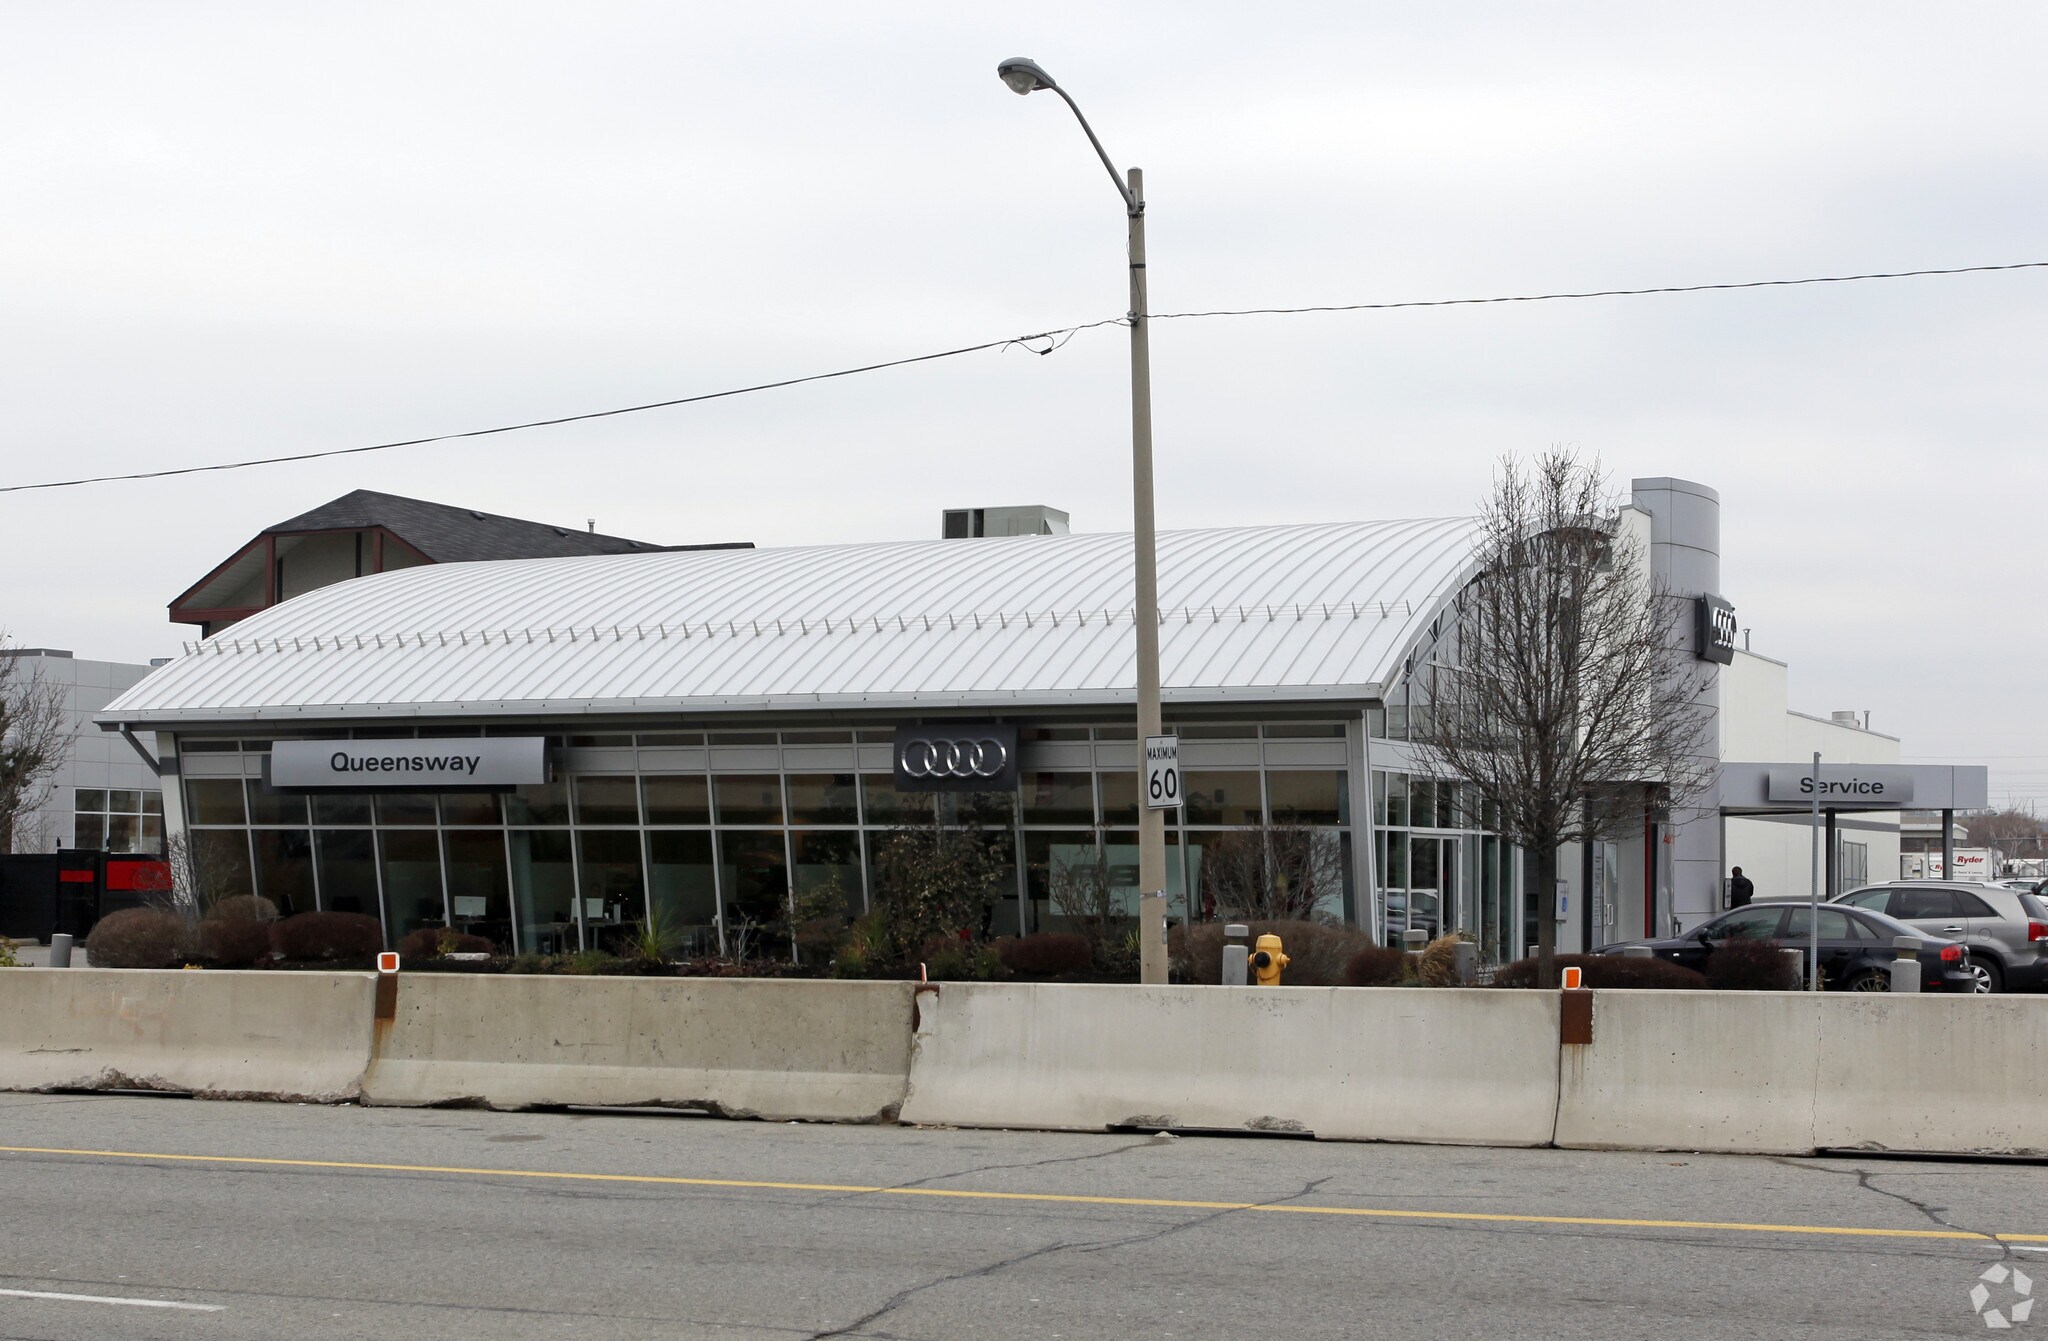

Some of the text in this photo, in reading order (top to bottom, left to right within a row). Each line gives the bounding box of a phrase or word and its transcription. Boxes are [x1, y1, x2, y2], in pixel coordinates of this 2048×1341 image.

[1147, 747, 1177, 760] MAXIMUM
[330, 751, 480, 775] Queensway
[1150, 767, 1177, 800] 60
[1799, 777, 1884, 794] Service
[1956, 855, 1984, 865] Ryder
